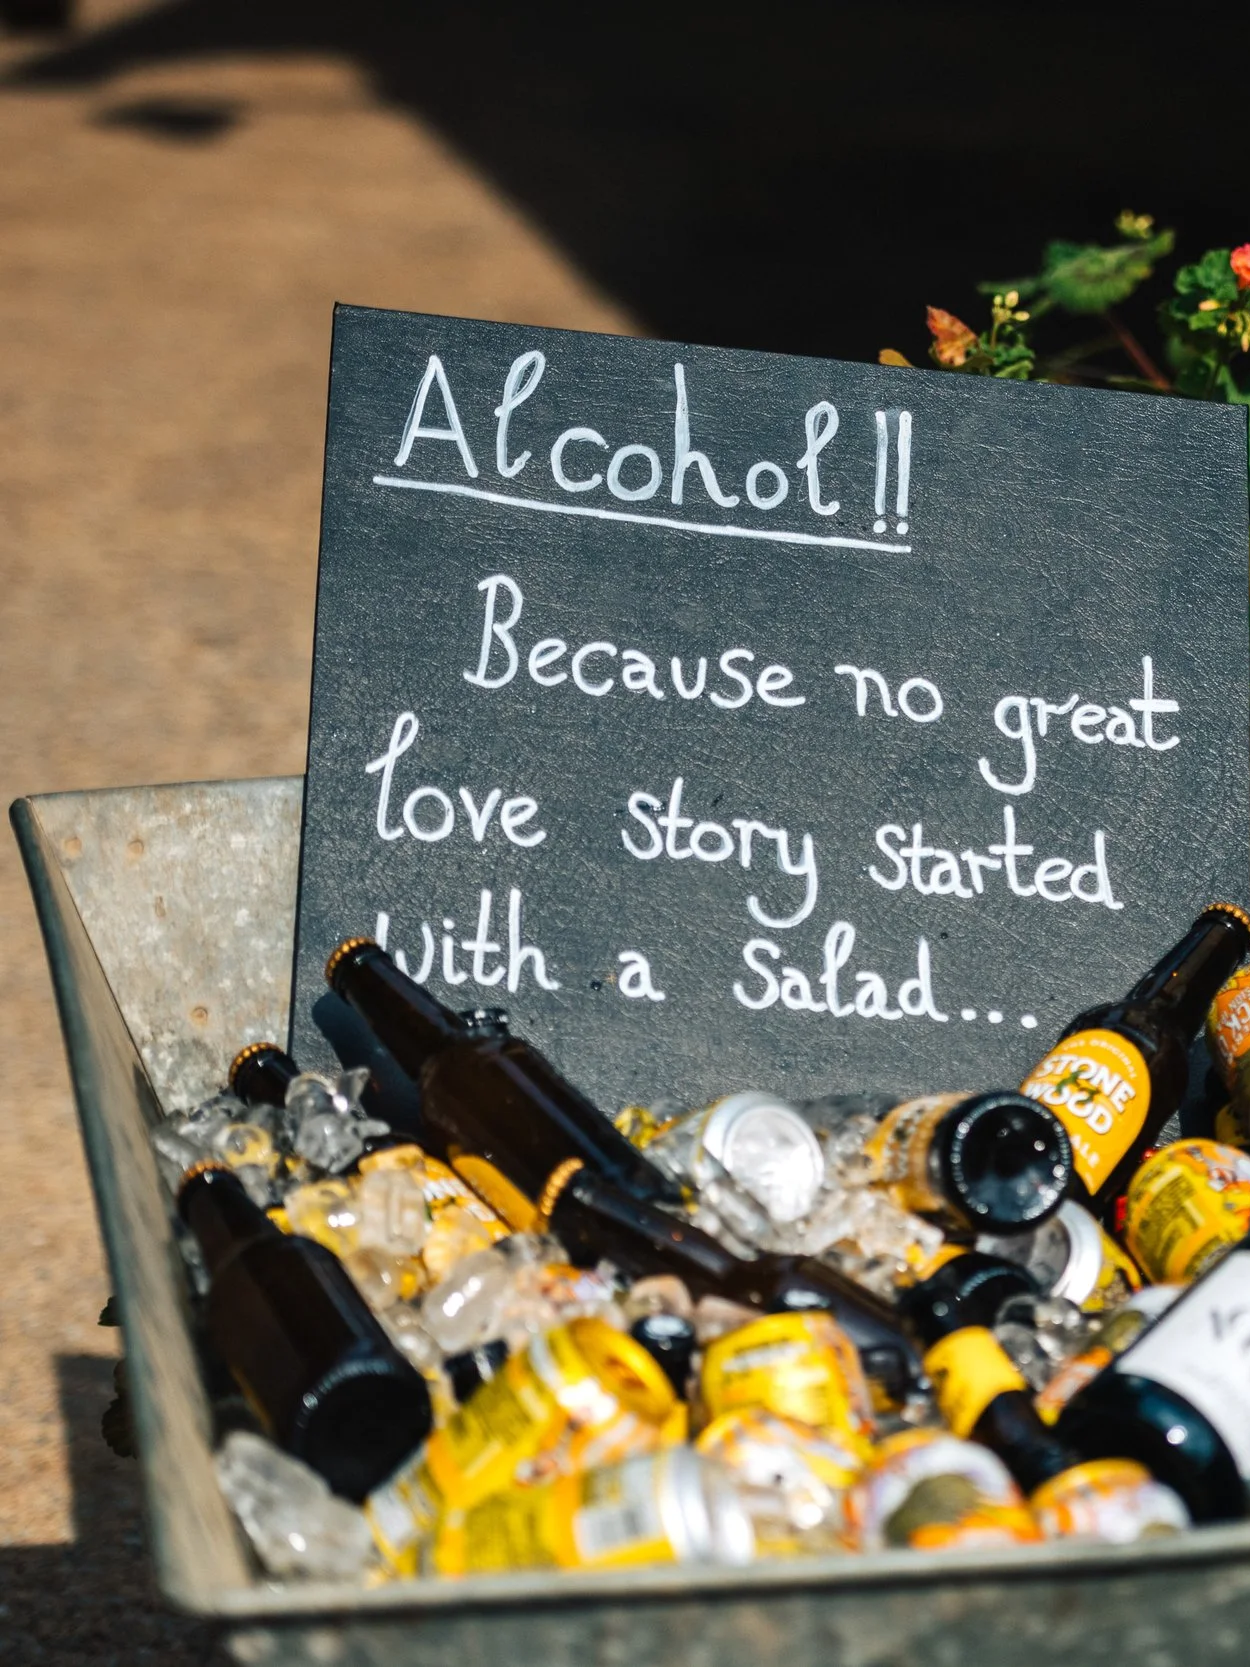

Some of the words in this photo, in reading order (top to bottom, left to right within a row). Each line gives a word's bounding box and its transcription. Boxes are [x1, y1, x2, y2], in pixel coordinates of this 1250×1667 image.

[463, 573, 806, 709] Because
[834, 664, 944, 723] no
[977, 655, 1181, 796] great
[364, 711, 547, 848] love
[618, 950, 666, 1002] a
[1023, 1081, 1114, 1135] WOOD
[1035, 1053, 1137, 1114] STONE
[1069, 1134, 1100, 1169] ALE
